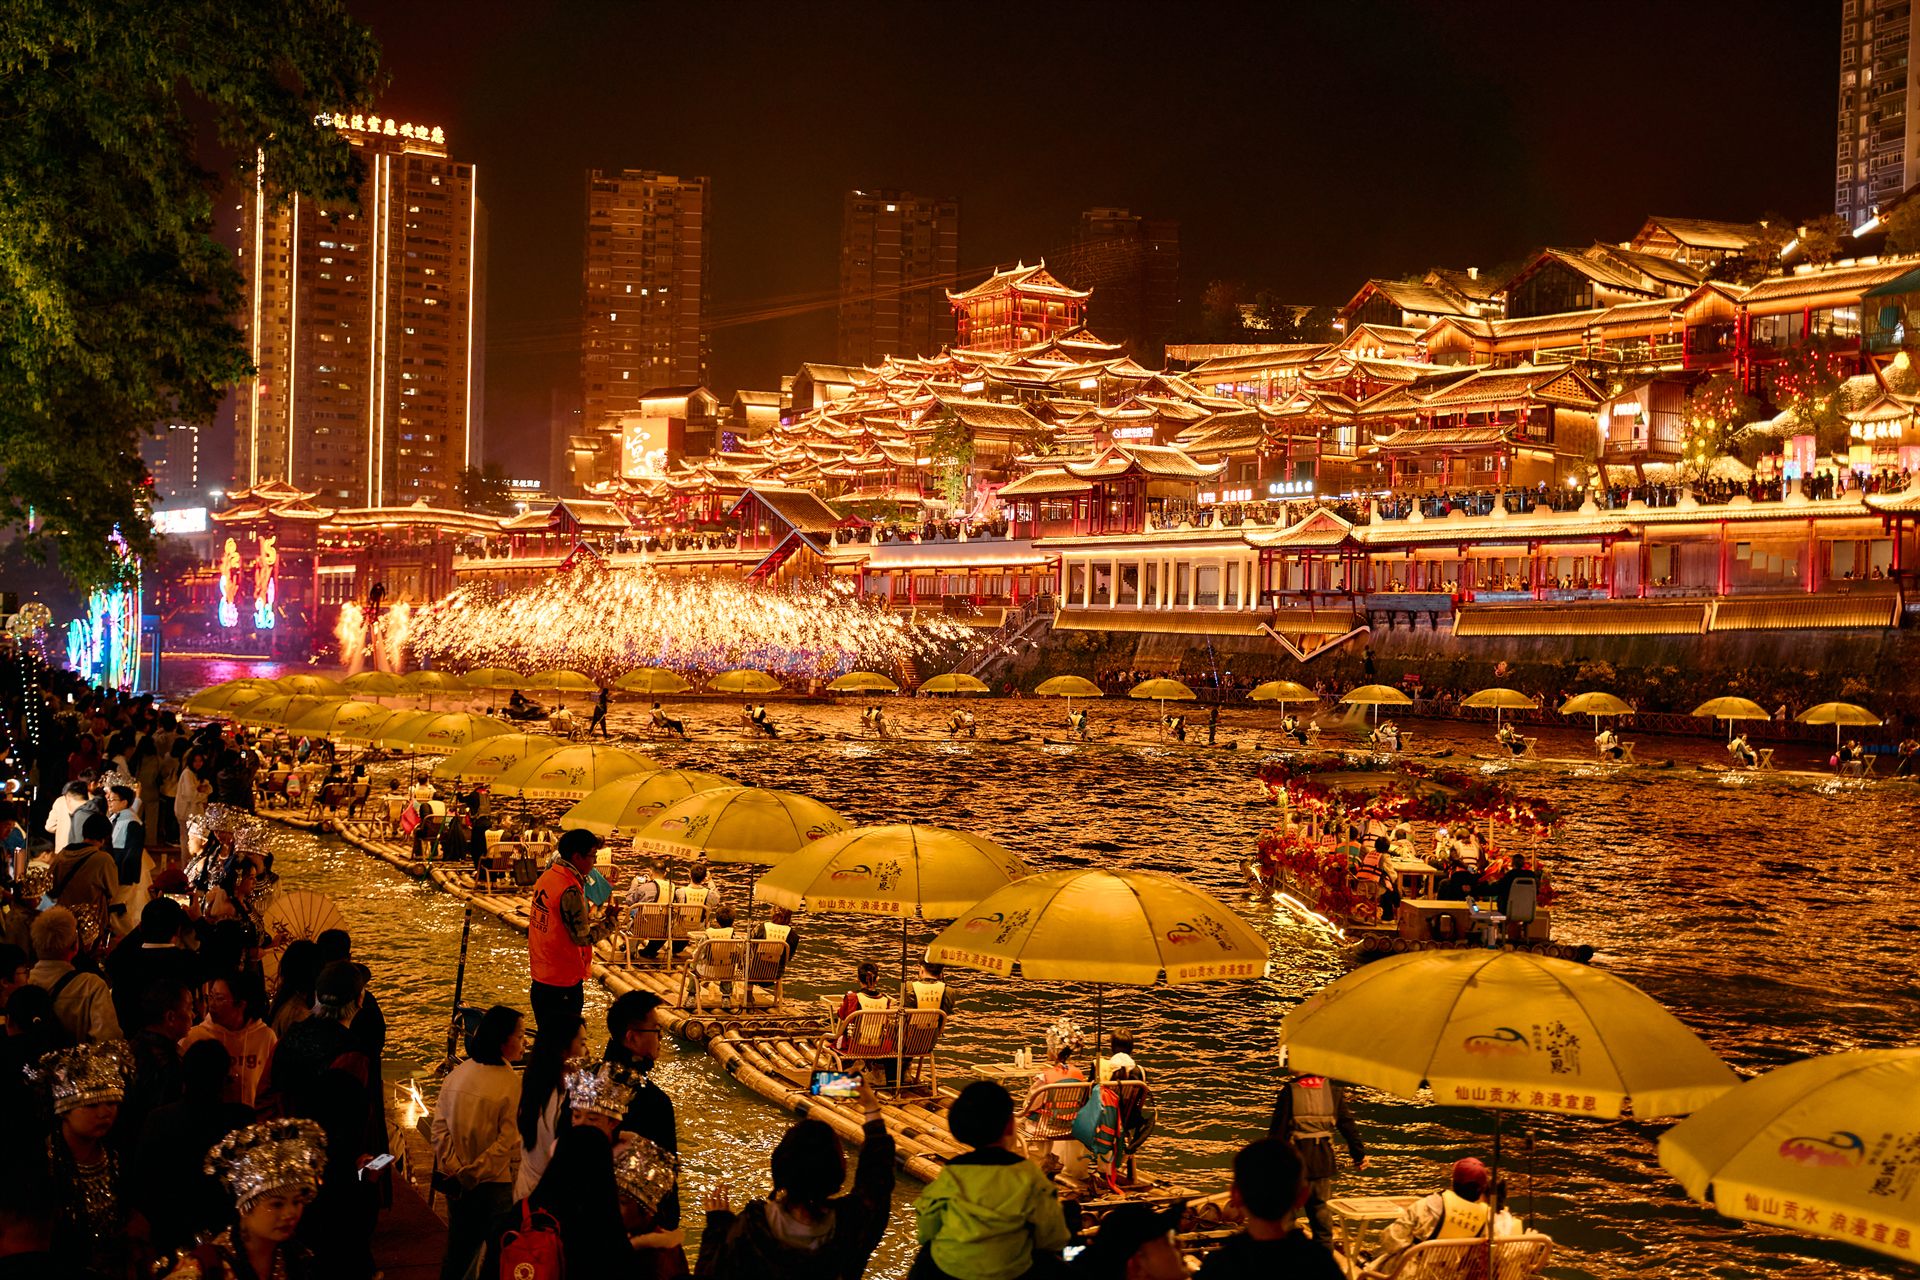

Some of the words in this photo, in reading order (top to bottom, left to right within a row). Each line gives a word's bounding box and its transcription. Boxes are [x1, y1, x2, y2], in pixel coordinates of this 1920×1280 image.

[818, 899, 857, 909] 仙山贡水
[860, 899, 900, 912] 浪漫宣恩
[940, 948, 970, 962] 仙山贡水
[972, 953, 1003, 971] 浪漫宣恩
[1180, 965, 1215, 979] 仙山贡水
[1219, 963, 1253, 976] 浪漫宣恩
[1454, 1085, 1522, 1104] 仙山贡水
[1530, 1090, 1597, 1111] 浪漫宣恩
[1744, 1192, 1820, 1225] 仙山贡水
[1829, 1211, 1911, 1250] 浪漫宣恩
